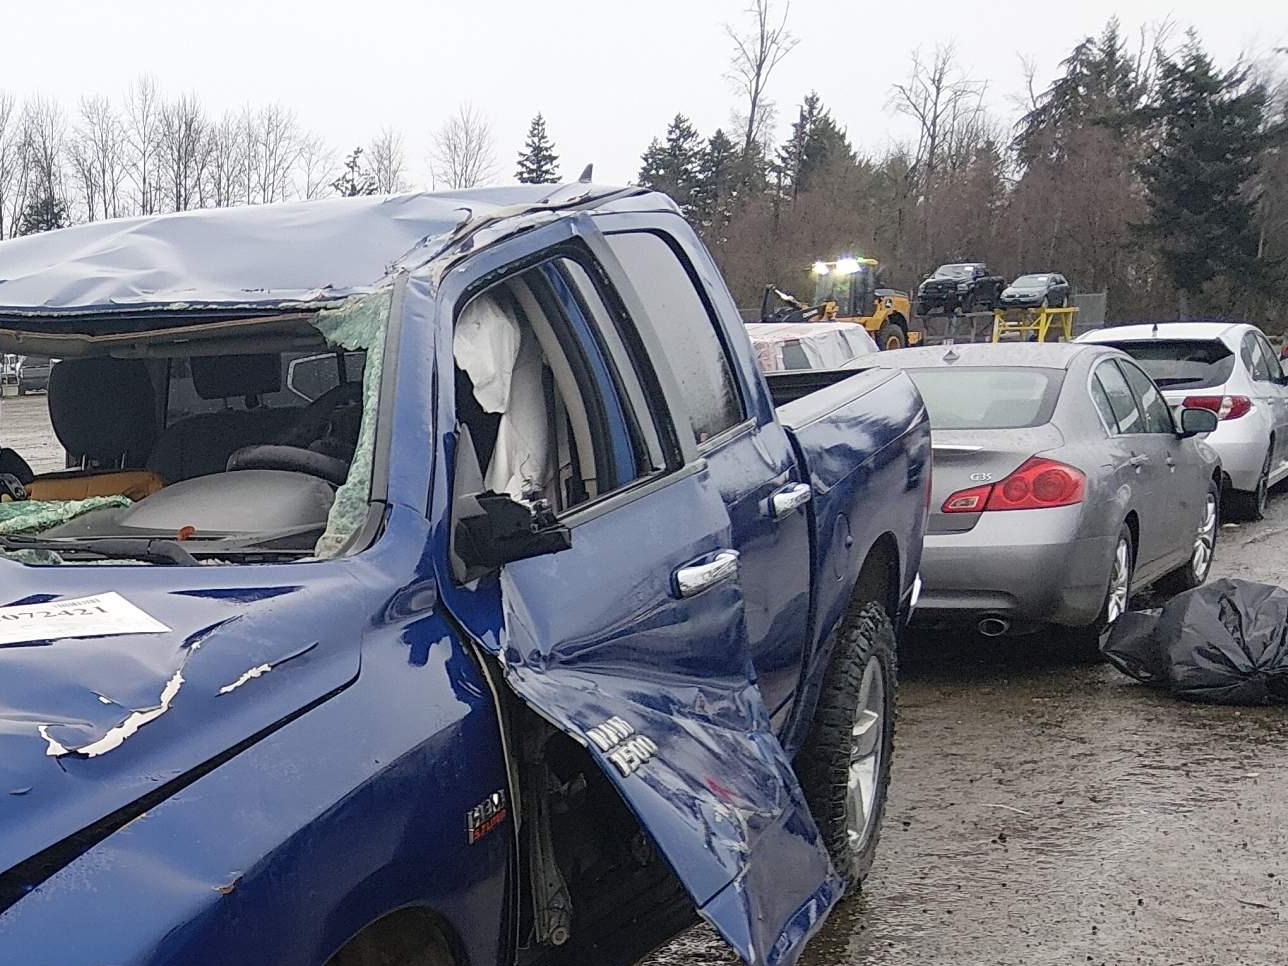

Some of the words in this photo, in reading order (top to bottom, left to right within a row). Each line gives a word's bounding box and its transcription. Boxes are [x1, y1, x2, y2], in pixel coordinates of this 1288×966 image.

[969, 472, 993, 481] G35
[585, 715, 635, 752] RAM
[608, 734, 658, 778] 1500
